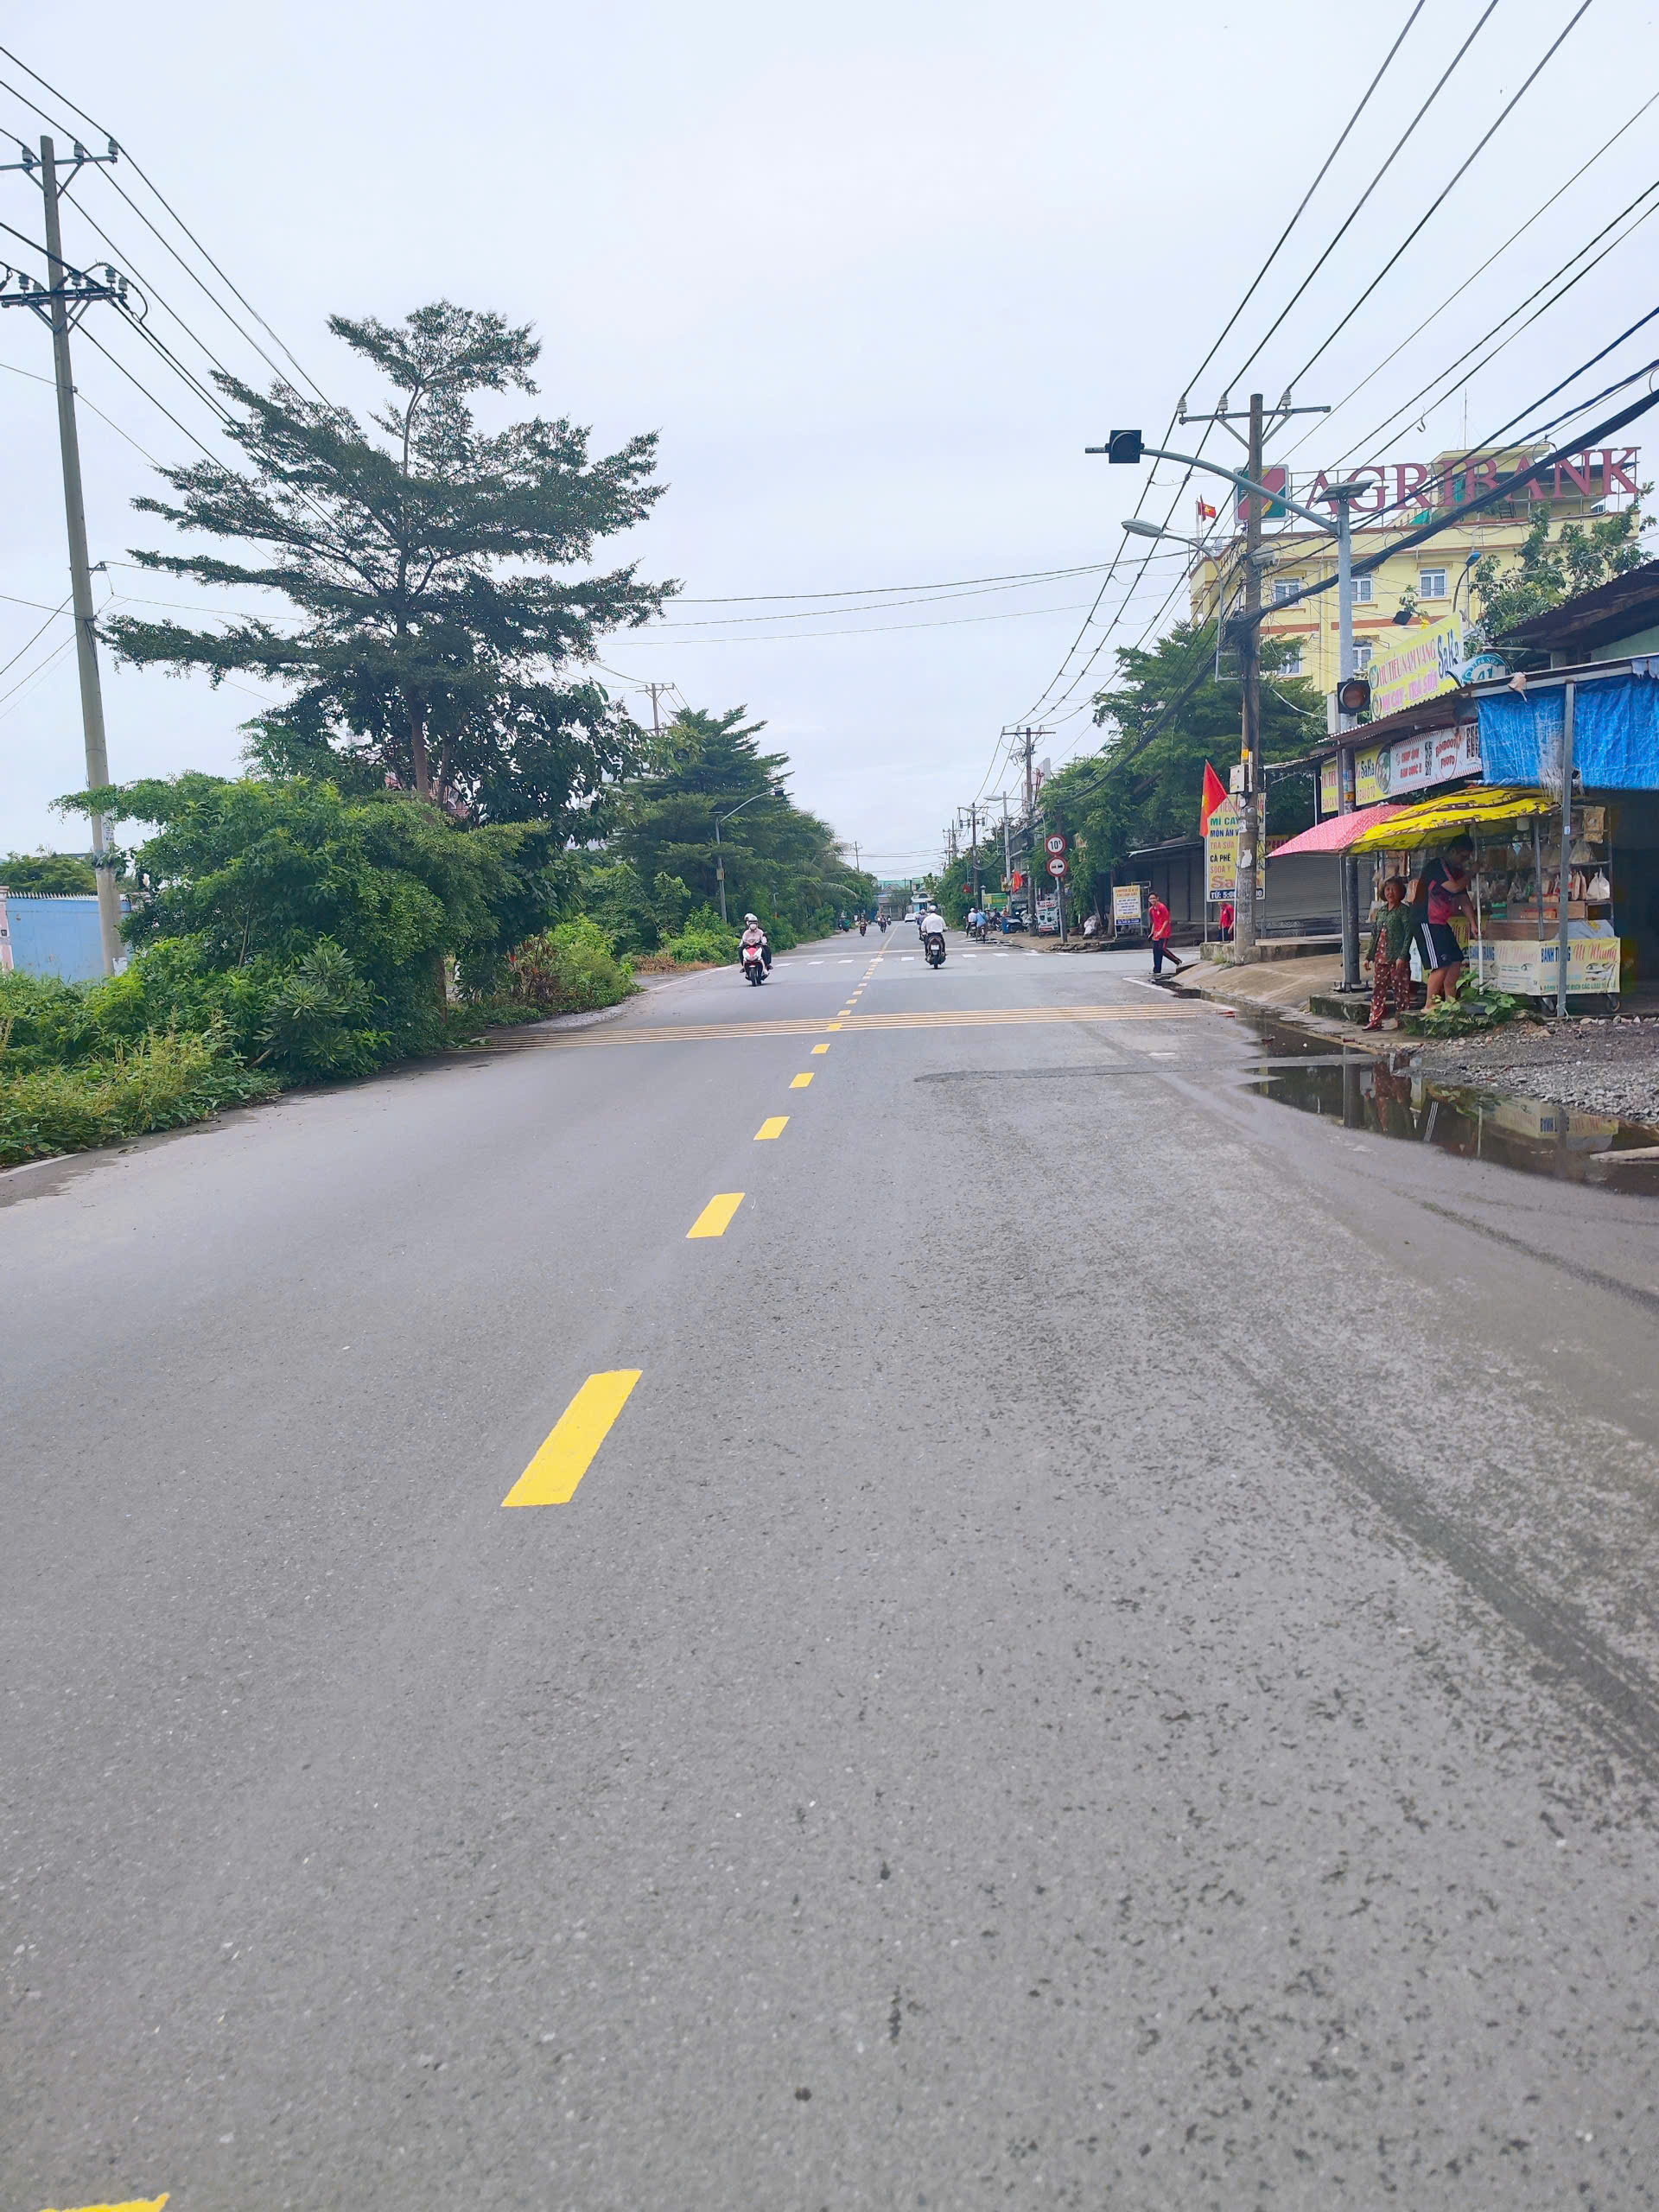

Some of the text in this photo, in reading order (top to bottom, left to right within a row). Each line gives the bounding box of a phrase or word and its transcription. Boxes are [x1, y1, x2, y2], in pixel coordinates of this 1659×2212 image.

[1305, 446, 1642, 515] AGRIBANK
[1402, 649, 1416, 672] NAM
[1416, 639, 1436, 666] VANG
[1440, 754, 1456, 769] PHOTO
[1219, 852, 1231, 862] PHÊ
